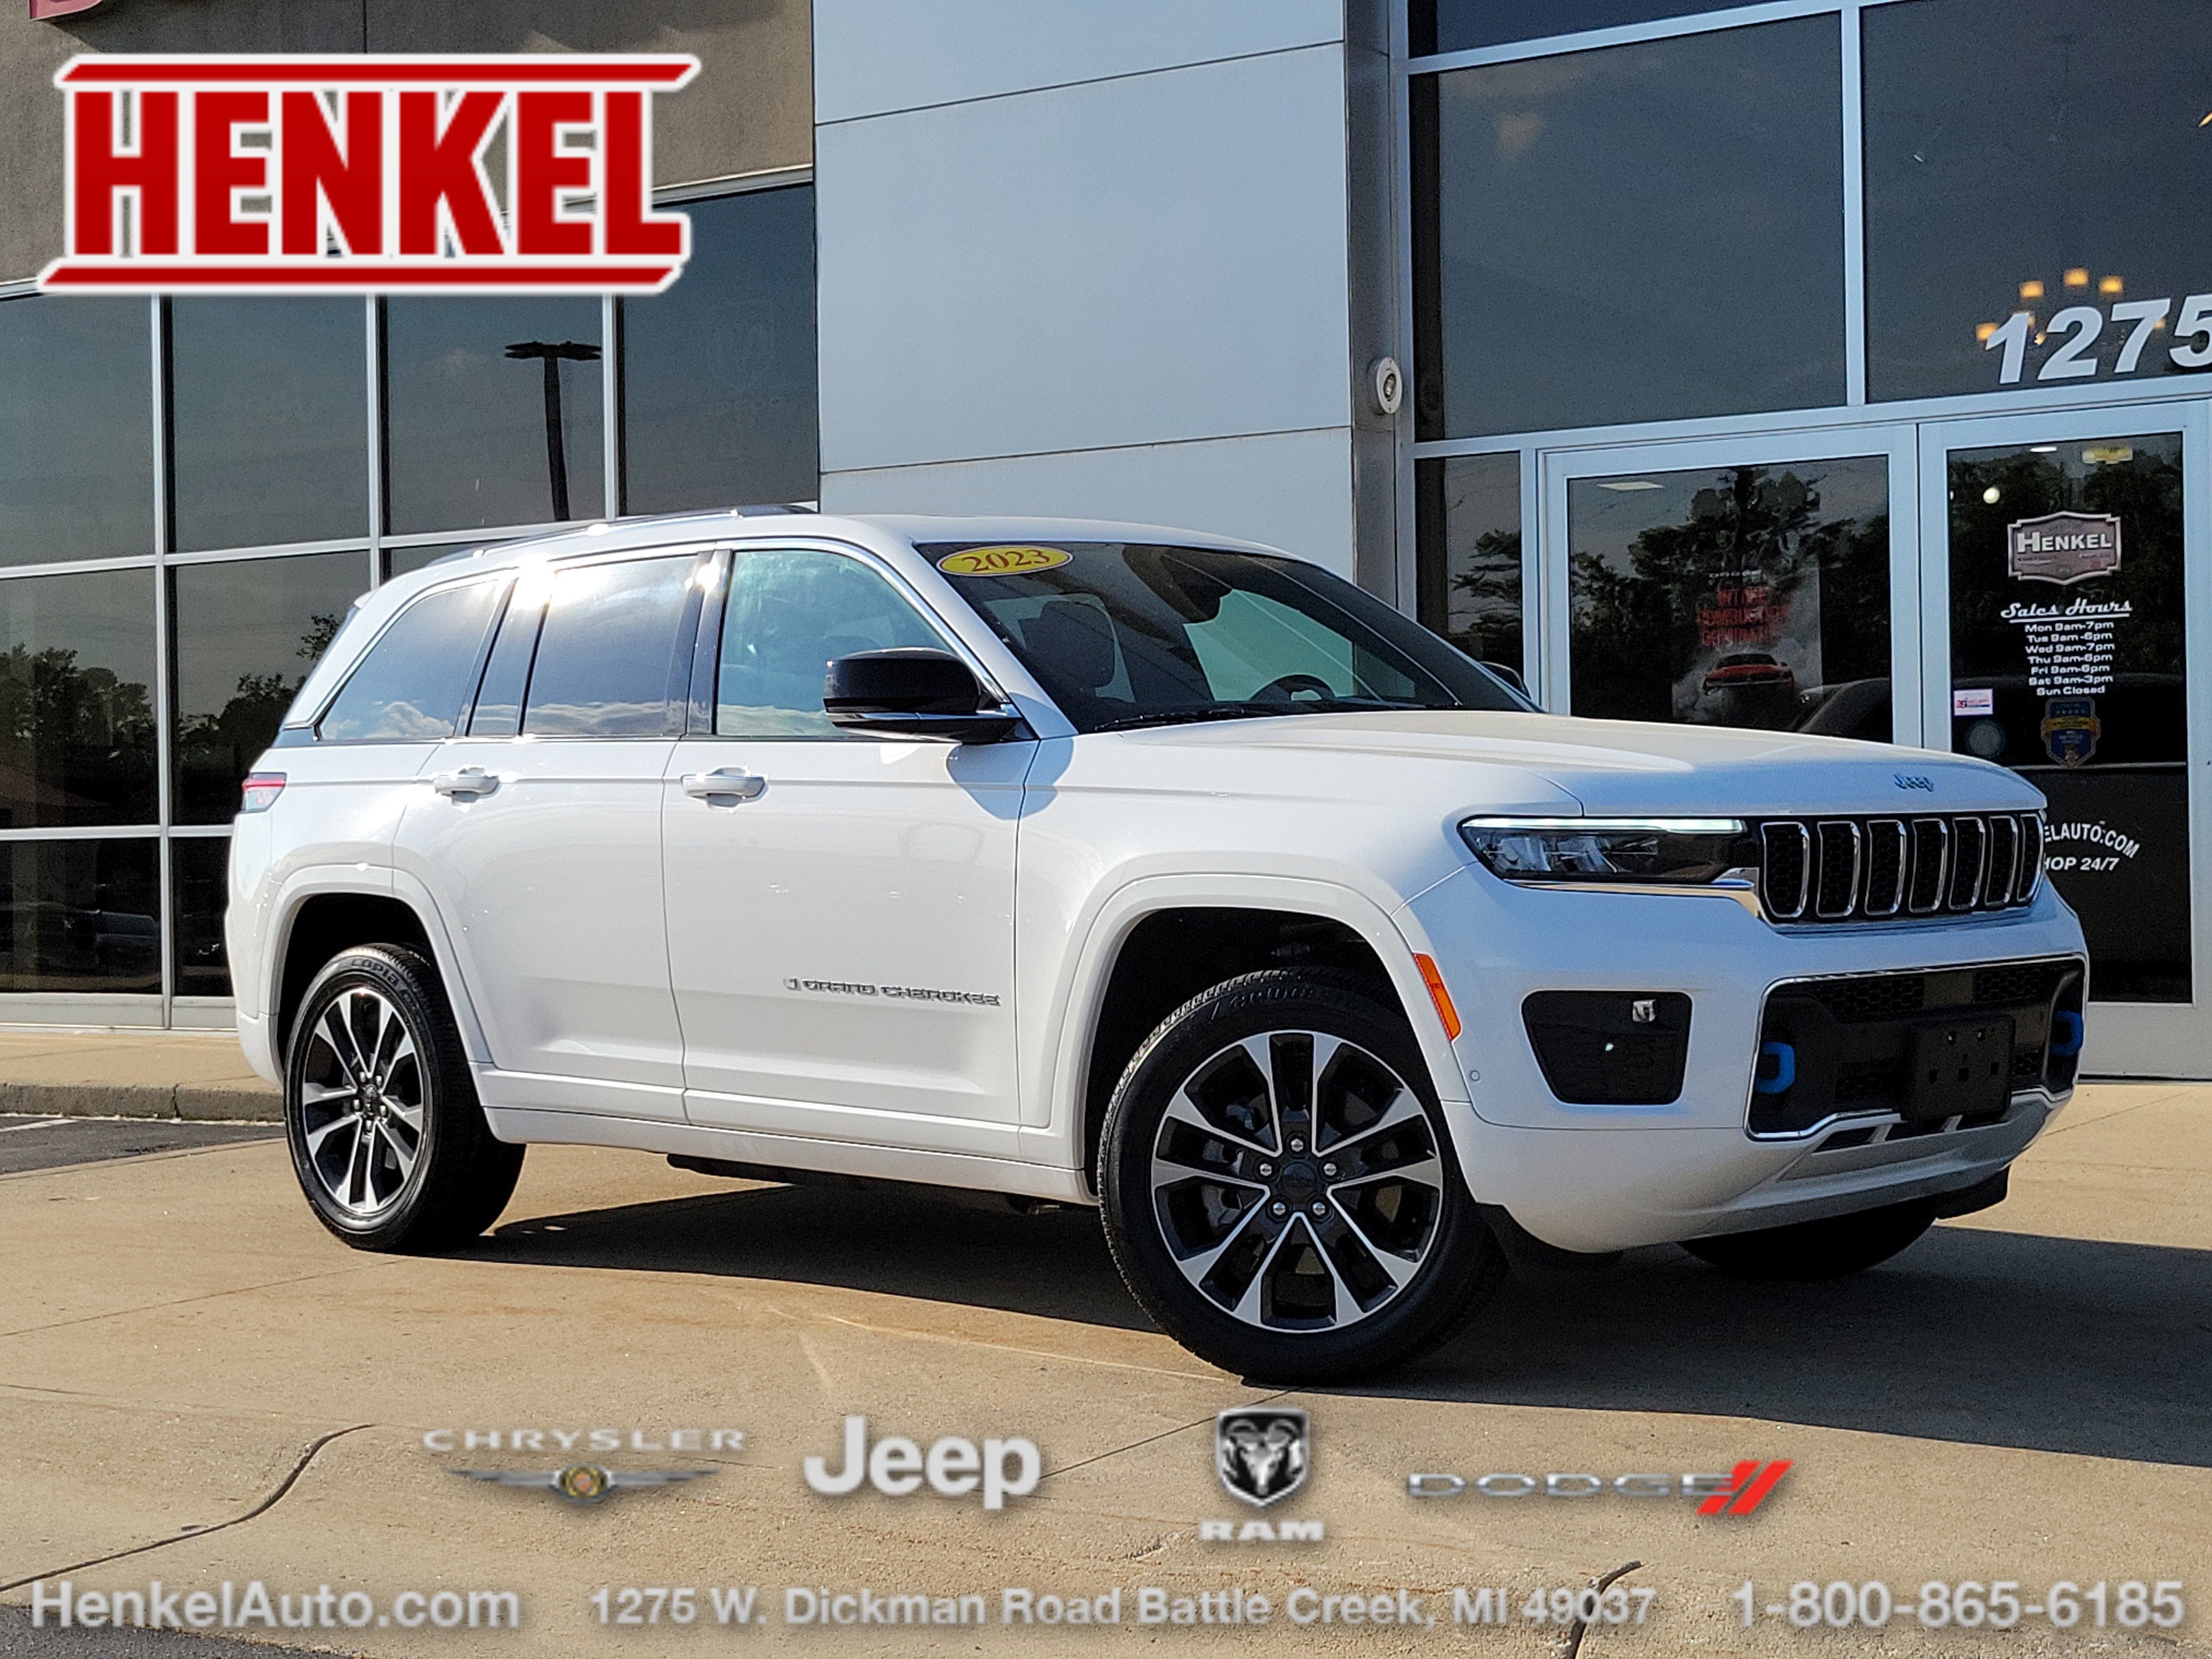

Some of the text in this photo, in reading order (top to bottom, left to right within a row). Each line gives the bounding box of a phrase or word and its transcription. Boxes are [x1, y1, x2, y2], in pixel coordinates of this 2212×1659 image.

[1985, 294, 2212, 384] 1275
[2017, 532, 2112, 553] HENKEL
[962, 549, 1051, 572] 2023
[2000, 597, 2133, 618] Sales Hours
[2024, 624, 2052, 633] Mon
[2026, 634, 2049, 643] Tue
[2025, 645, 2053, 653] Wed
[2027, 656, 2051, 664] Thu
[2031, 666, 2049, 675] Fri
[2029, 676, 2052, 686] Sat
[2036, 685, 2106, 696] Sun Closed
[1893, 774, 1934, 792] Jeep
[2044, 822, 2140, 859] ELAUTO.COM
[2044, 856, 2120, 871] HOP 24/7
[803, 979, 1002, 1007] GRAND CHEROKEE
